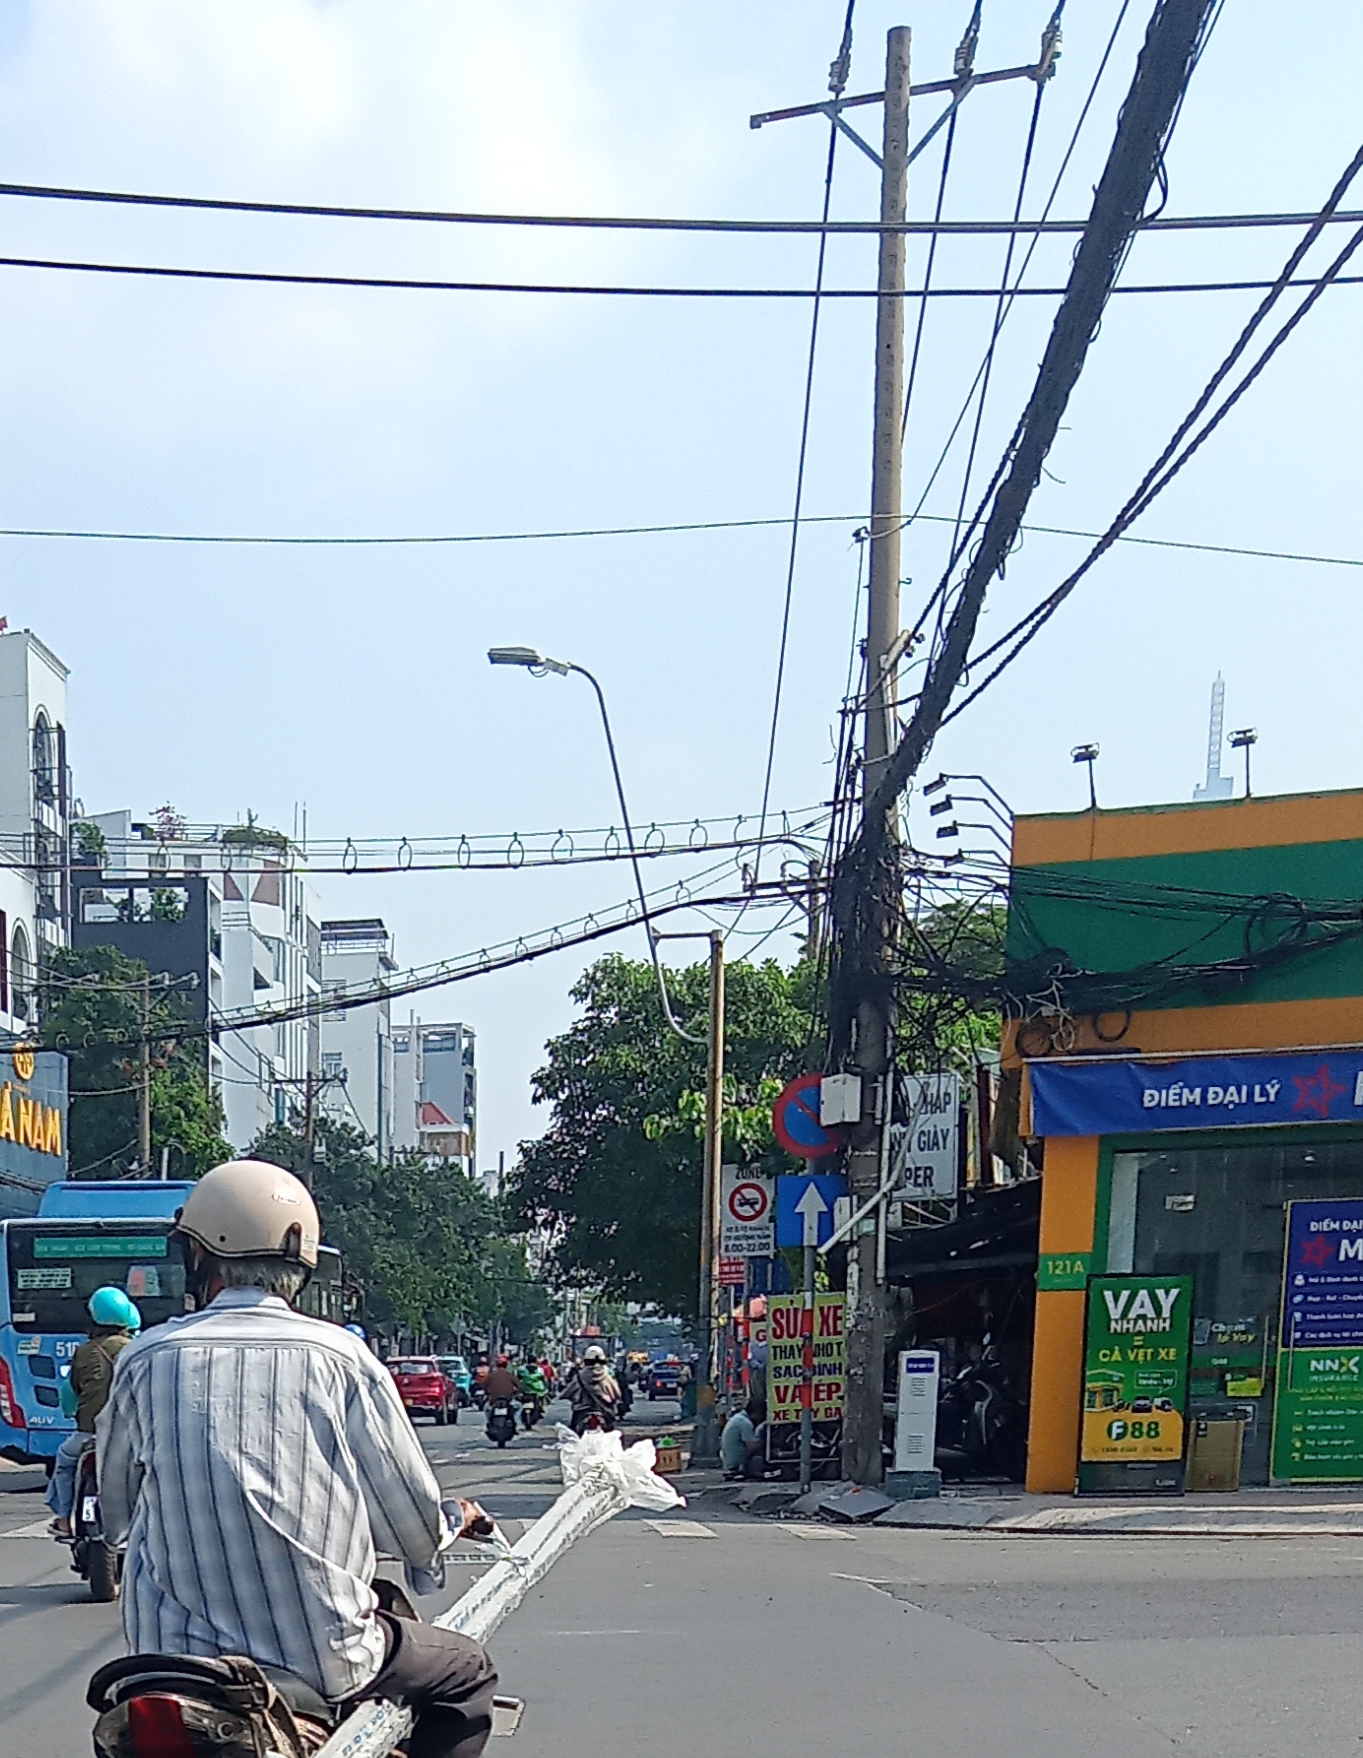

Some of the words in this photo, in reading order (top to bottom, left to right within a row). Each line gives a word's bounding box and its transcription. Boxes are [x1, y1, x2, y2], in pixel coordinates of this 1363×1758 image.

[1143, 1081, 1202, 1108] ĐIỂM
[1207, 1085, 1249, 1110] ĐẠI
[1254, 1079, 1281, 1104] LÝ
[16, 1096, 62, 1156] NAM
[1310, 1218, 1340, 1233] ĐIỂM
[1047, 1260, 1085, 1275] 121A
[1103, 1288, 1181, 1319] VAY
[819, 1305, 844, 1337] XE
[1110, 1318, 1171, 1333] NHANH
[1158, 1347, 1177, 1360] XE
[773, 1410, 789, 1421] XE
[824, 1406, 842, 1418] GA
